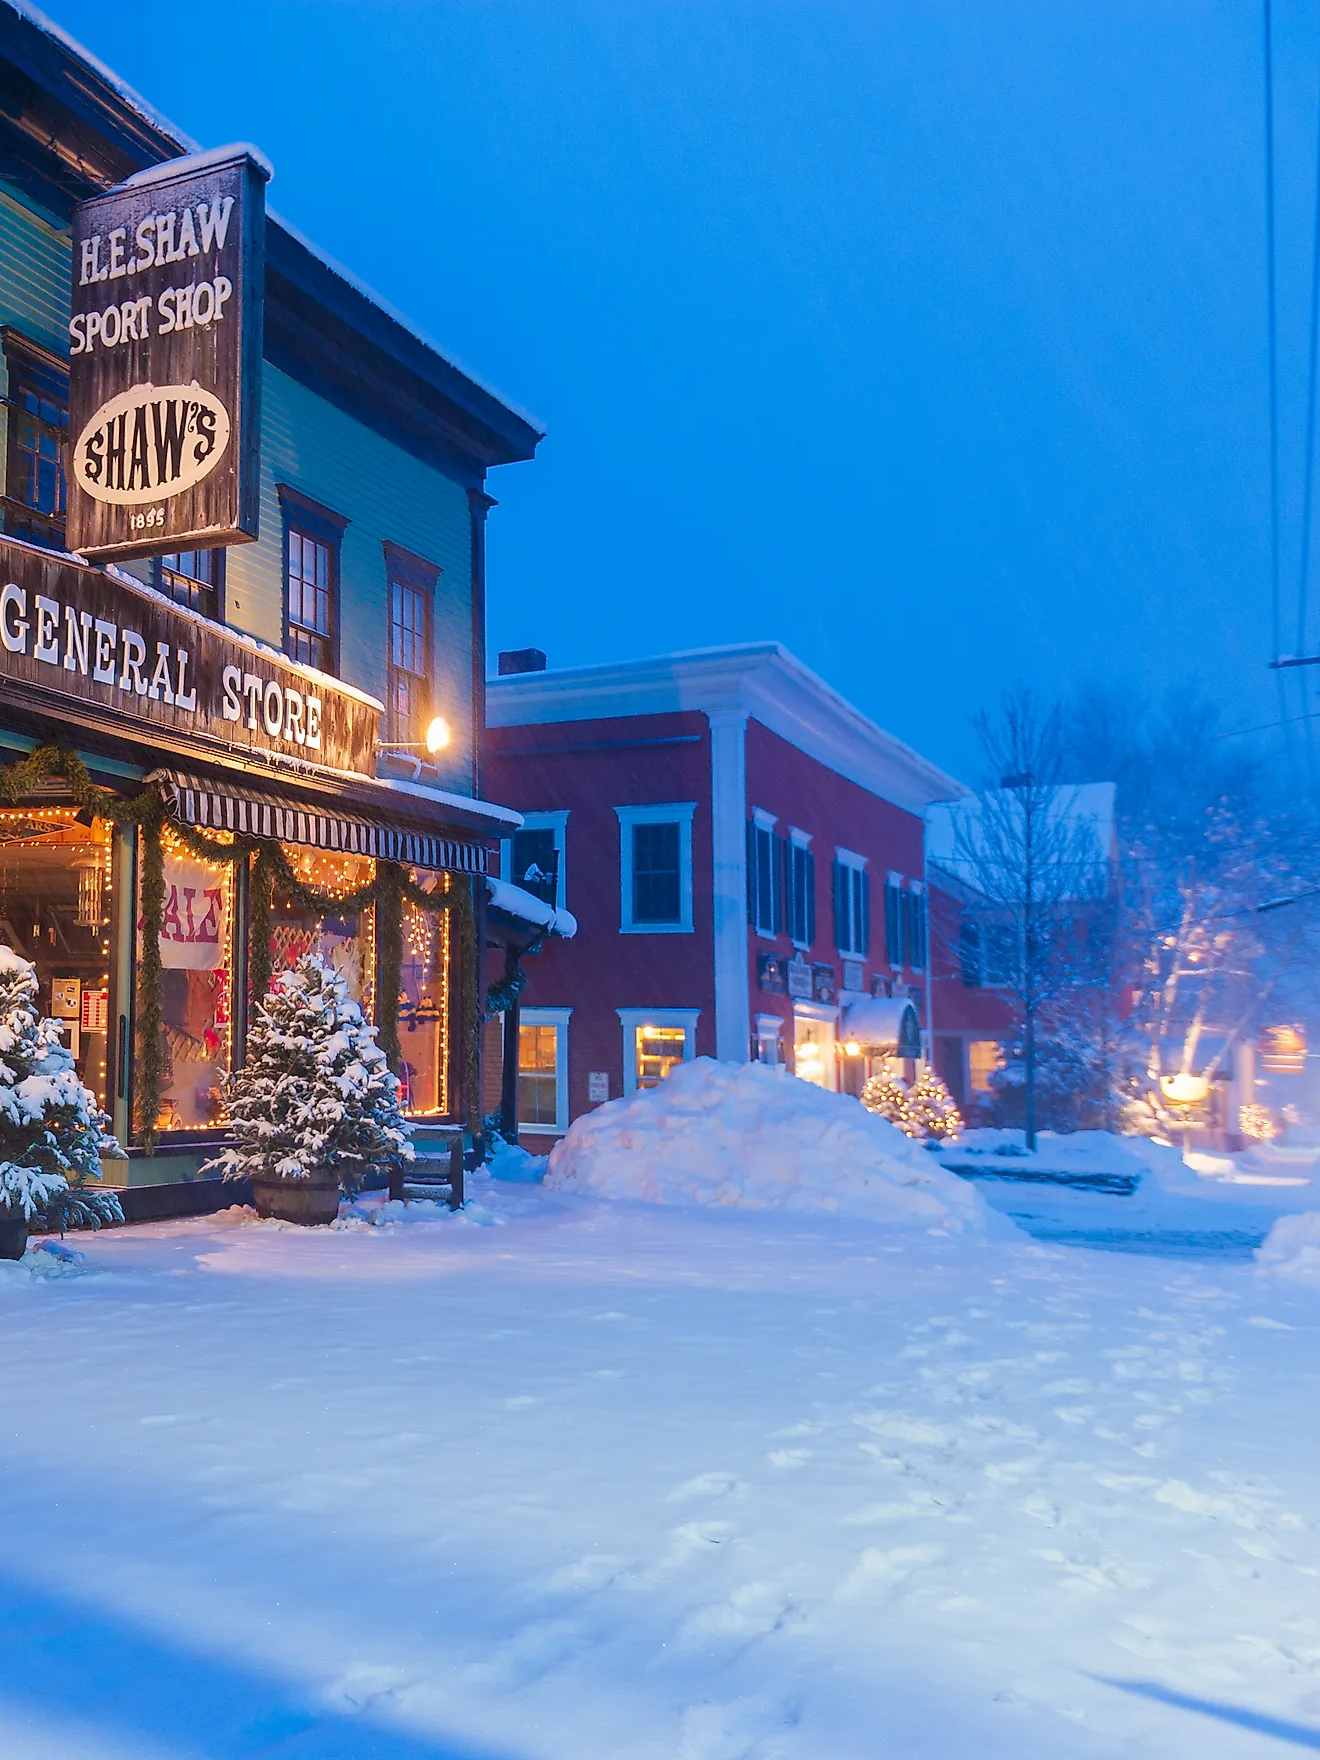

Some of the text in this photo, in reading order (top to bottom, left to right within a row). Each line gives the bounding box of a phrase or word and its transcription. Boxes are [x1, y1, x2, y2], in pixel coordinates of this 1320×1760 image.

[69, 275, 233, 356] SPORT SHOP
[84, 399, 218, 491] SHAW'S
[130, 507, 166, 530] 1895
[0, 583, 198, 713] GENERAL
[222, 664, 323, 750] STORE
